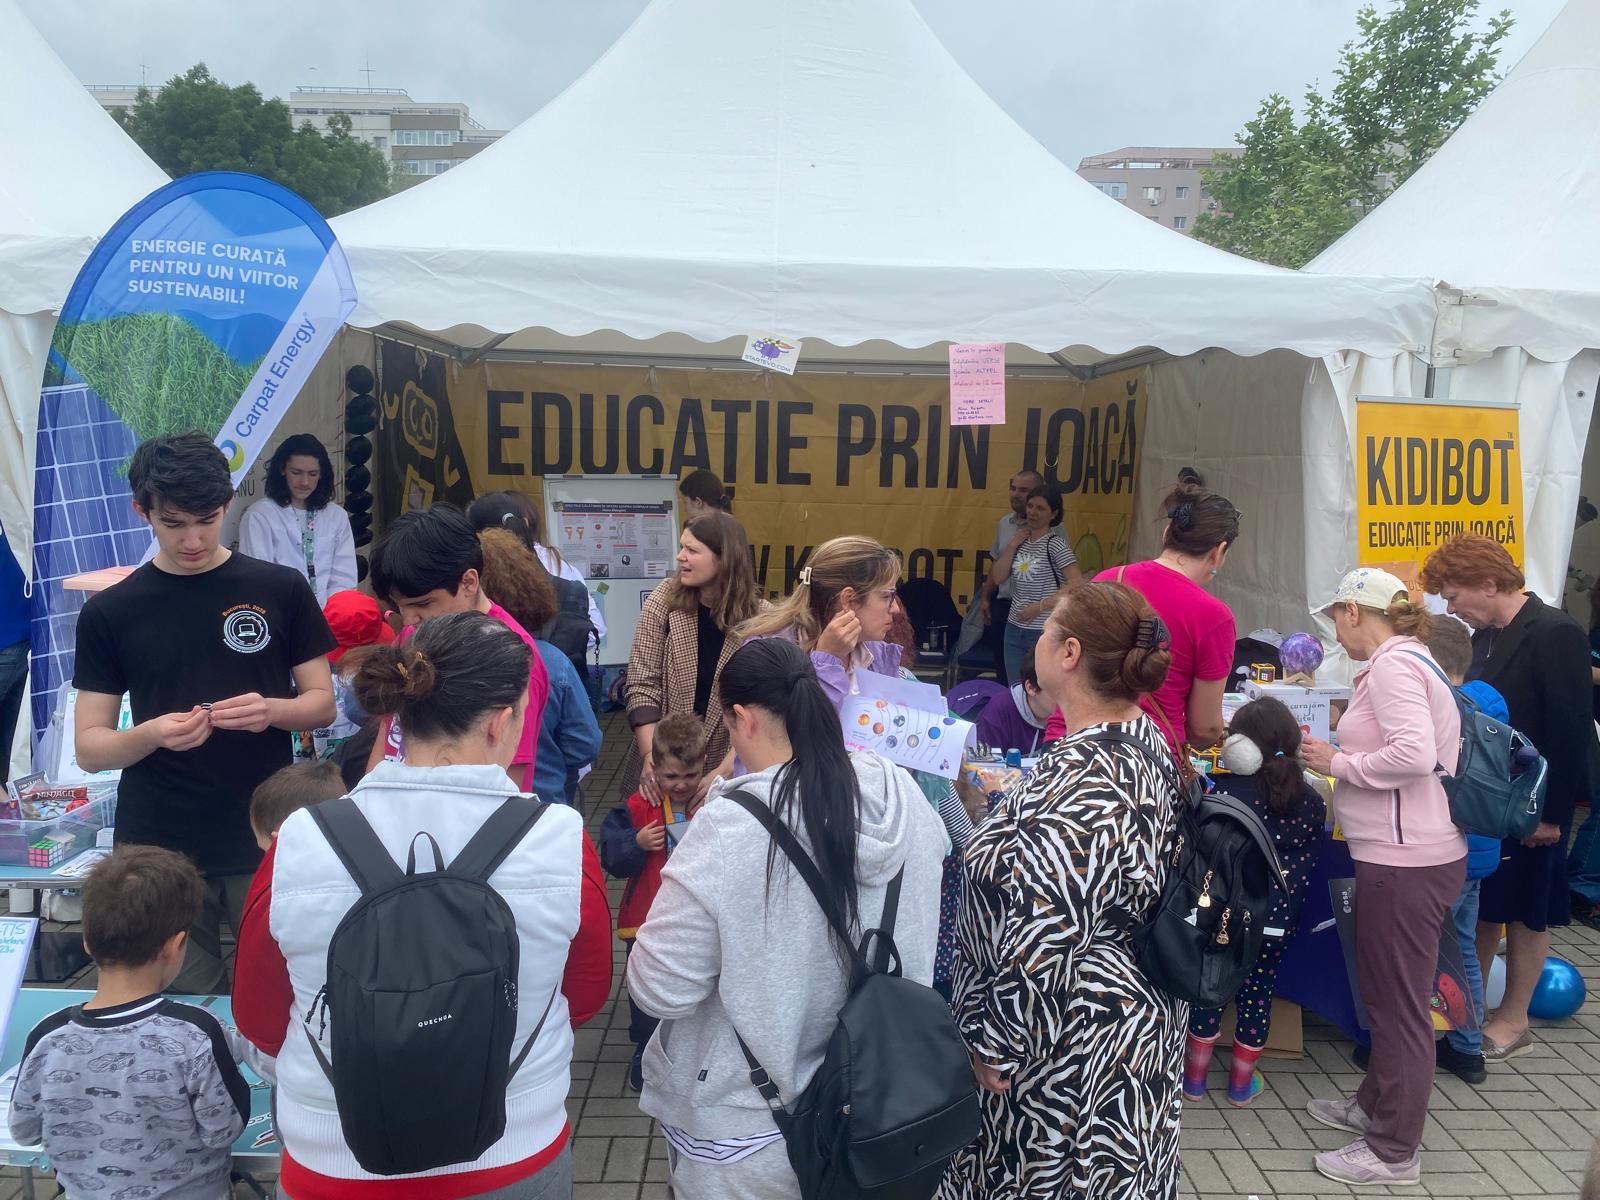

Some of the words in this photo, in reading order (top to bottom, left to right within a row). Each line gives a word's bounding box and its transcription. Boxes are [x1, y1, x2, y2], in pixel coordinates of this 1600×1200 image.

[131, 239, 207, 256] ENERGIE
[212, 243, 287, 268] CURATĂ
[129, 259, 201, 276] PENTRU
[207, 264, 234, 281] UN
[239, 268, 299, 290] VIITOR
[127, 280, 246, 305] SUSTENABIL!
[235, 378, 279, 438] Carpat
[270, 317, 316, 380] Energy
[836, 403, 991, 490] PRIN
[1366, 435, 1515, 506] KIDIBOT
[1368, 520, 1432, 552] EDUCAȚIE
[36, 789, 77, 800] NINJAGO
[417, 1014, 452, 1028] QUECHUA
